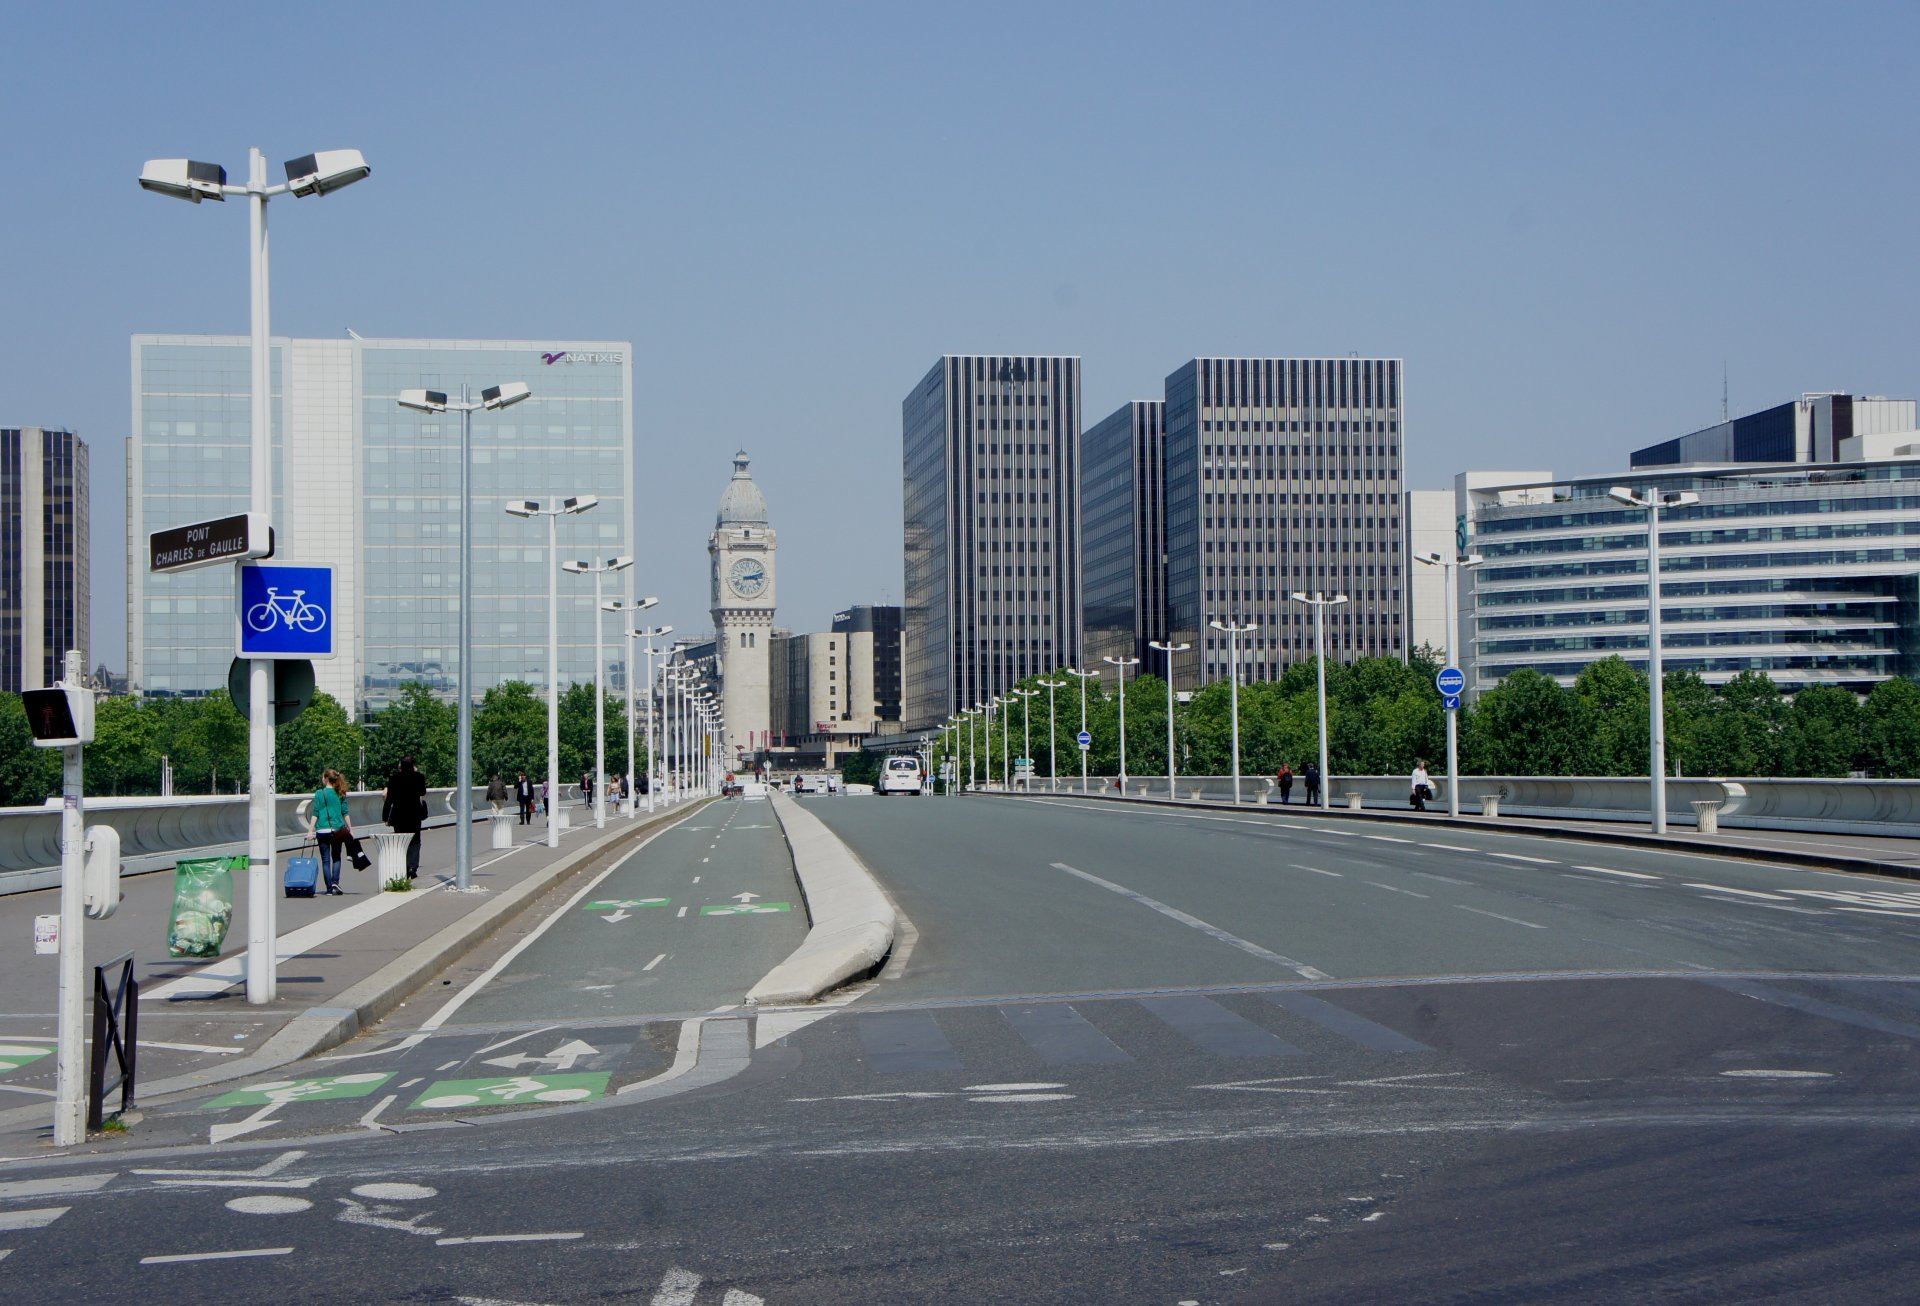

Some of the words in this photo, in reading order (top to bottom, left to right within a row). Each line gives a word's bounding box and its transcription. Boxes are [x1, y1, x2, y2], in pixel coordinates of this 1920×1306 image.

[566, 353, 622, 363] NATIXIS
[187, 527, 210, 543] PONT
[156, 547, 193, 566] CHARLES
[198, 549, 205, 558] DE
[210, 537, 243, 555] GAULLE
